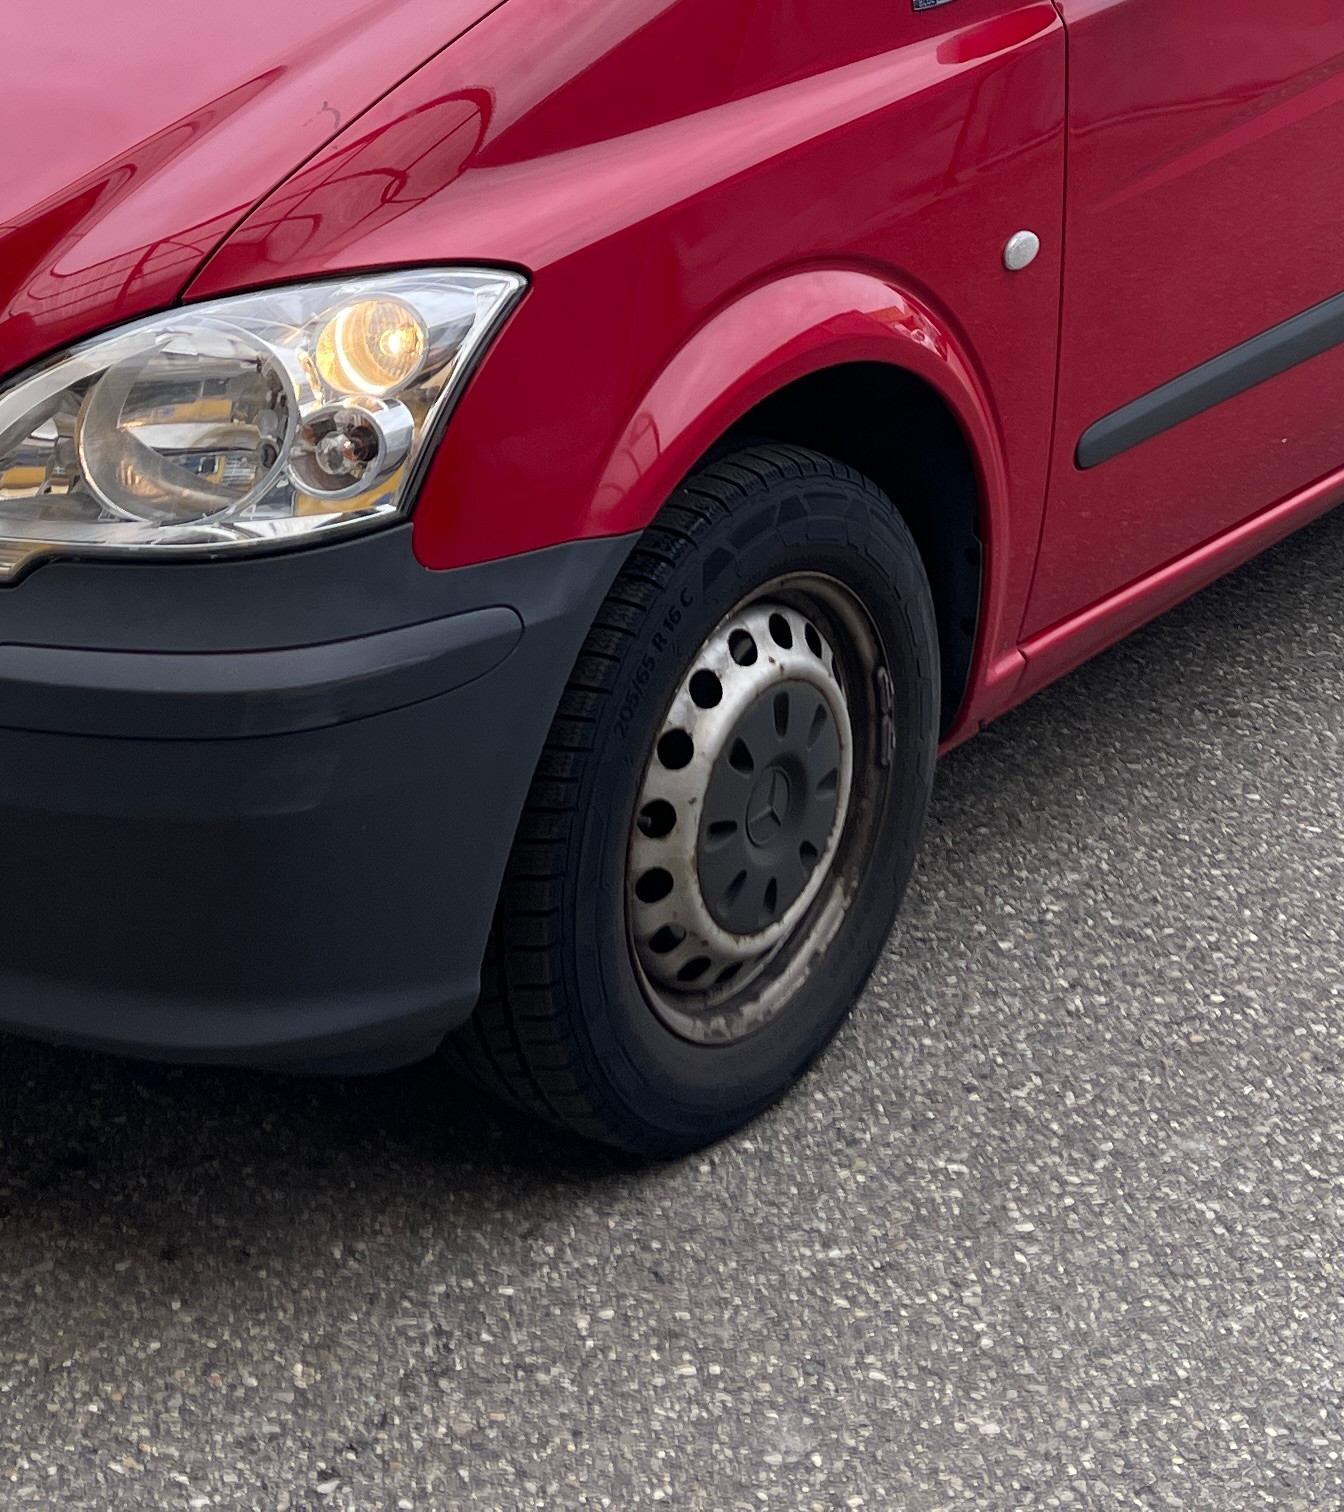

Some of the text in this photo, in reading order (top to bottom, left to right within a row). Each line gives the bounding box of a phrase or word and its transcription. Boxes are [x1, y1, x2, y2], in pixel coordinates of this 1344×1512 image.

[613, 587, 694, 737] 205/65 R 16 C
